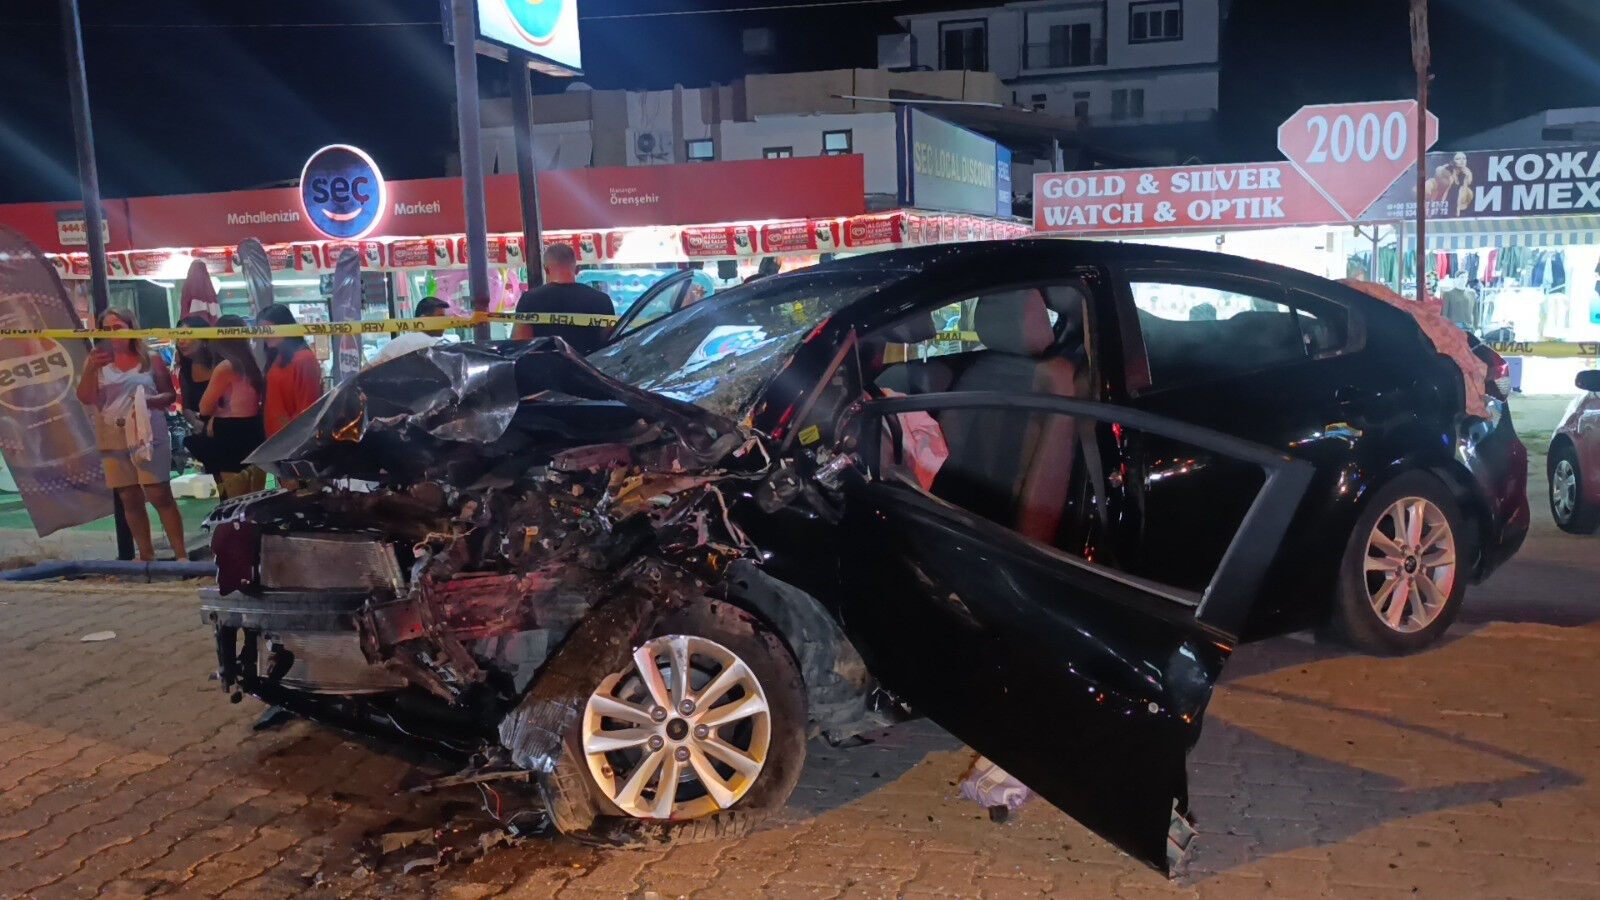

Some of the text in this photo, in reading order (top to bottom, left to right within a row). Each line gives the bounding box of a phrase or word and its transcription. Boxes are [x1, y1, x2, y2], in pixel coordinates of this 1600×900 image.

[1305, 112, 1407, 163] 2000
[935, 148, 961, 181] LOCAL
[962, 157, 995, 188] DISCOUNT
[311, 176, 370, 205] seç
[1042, 167, 1283, 199] GOLD & SILVER
[394, 201, 441, 215] Marketi
[610, 193, 660, 206] Örenşehir
[1043, 197, 1285, 226] WATCH & OPTIK
[1474, 186, 1502, 211] И
[227, 210, 300, 225] Mahallenizin
